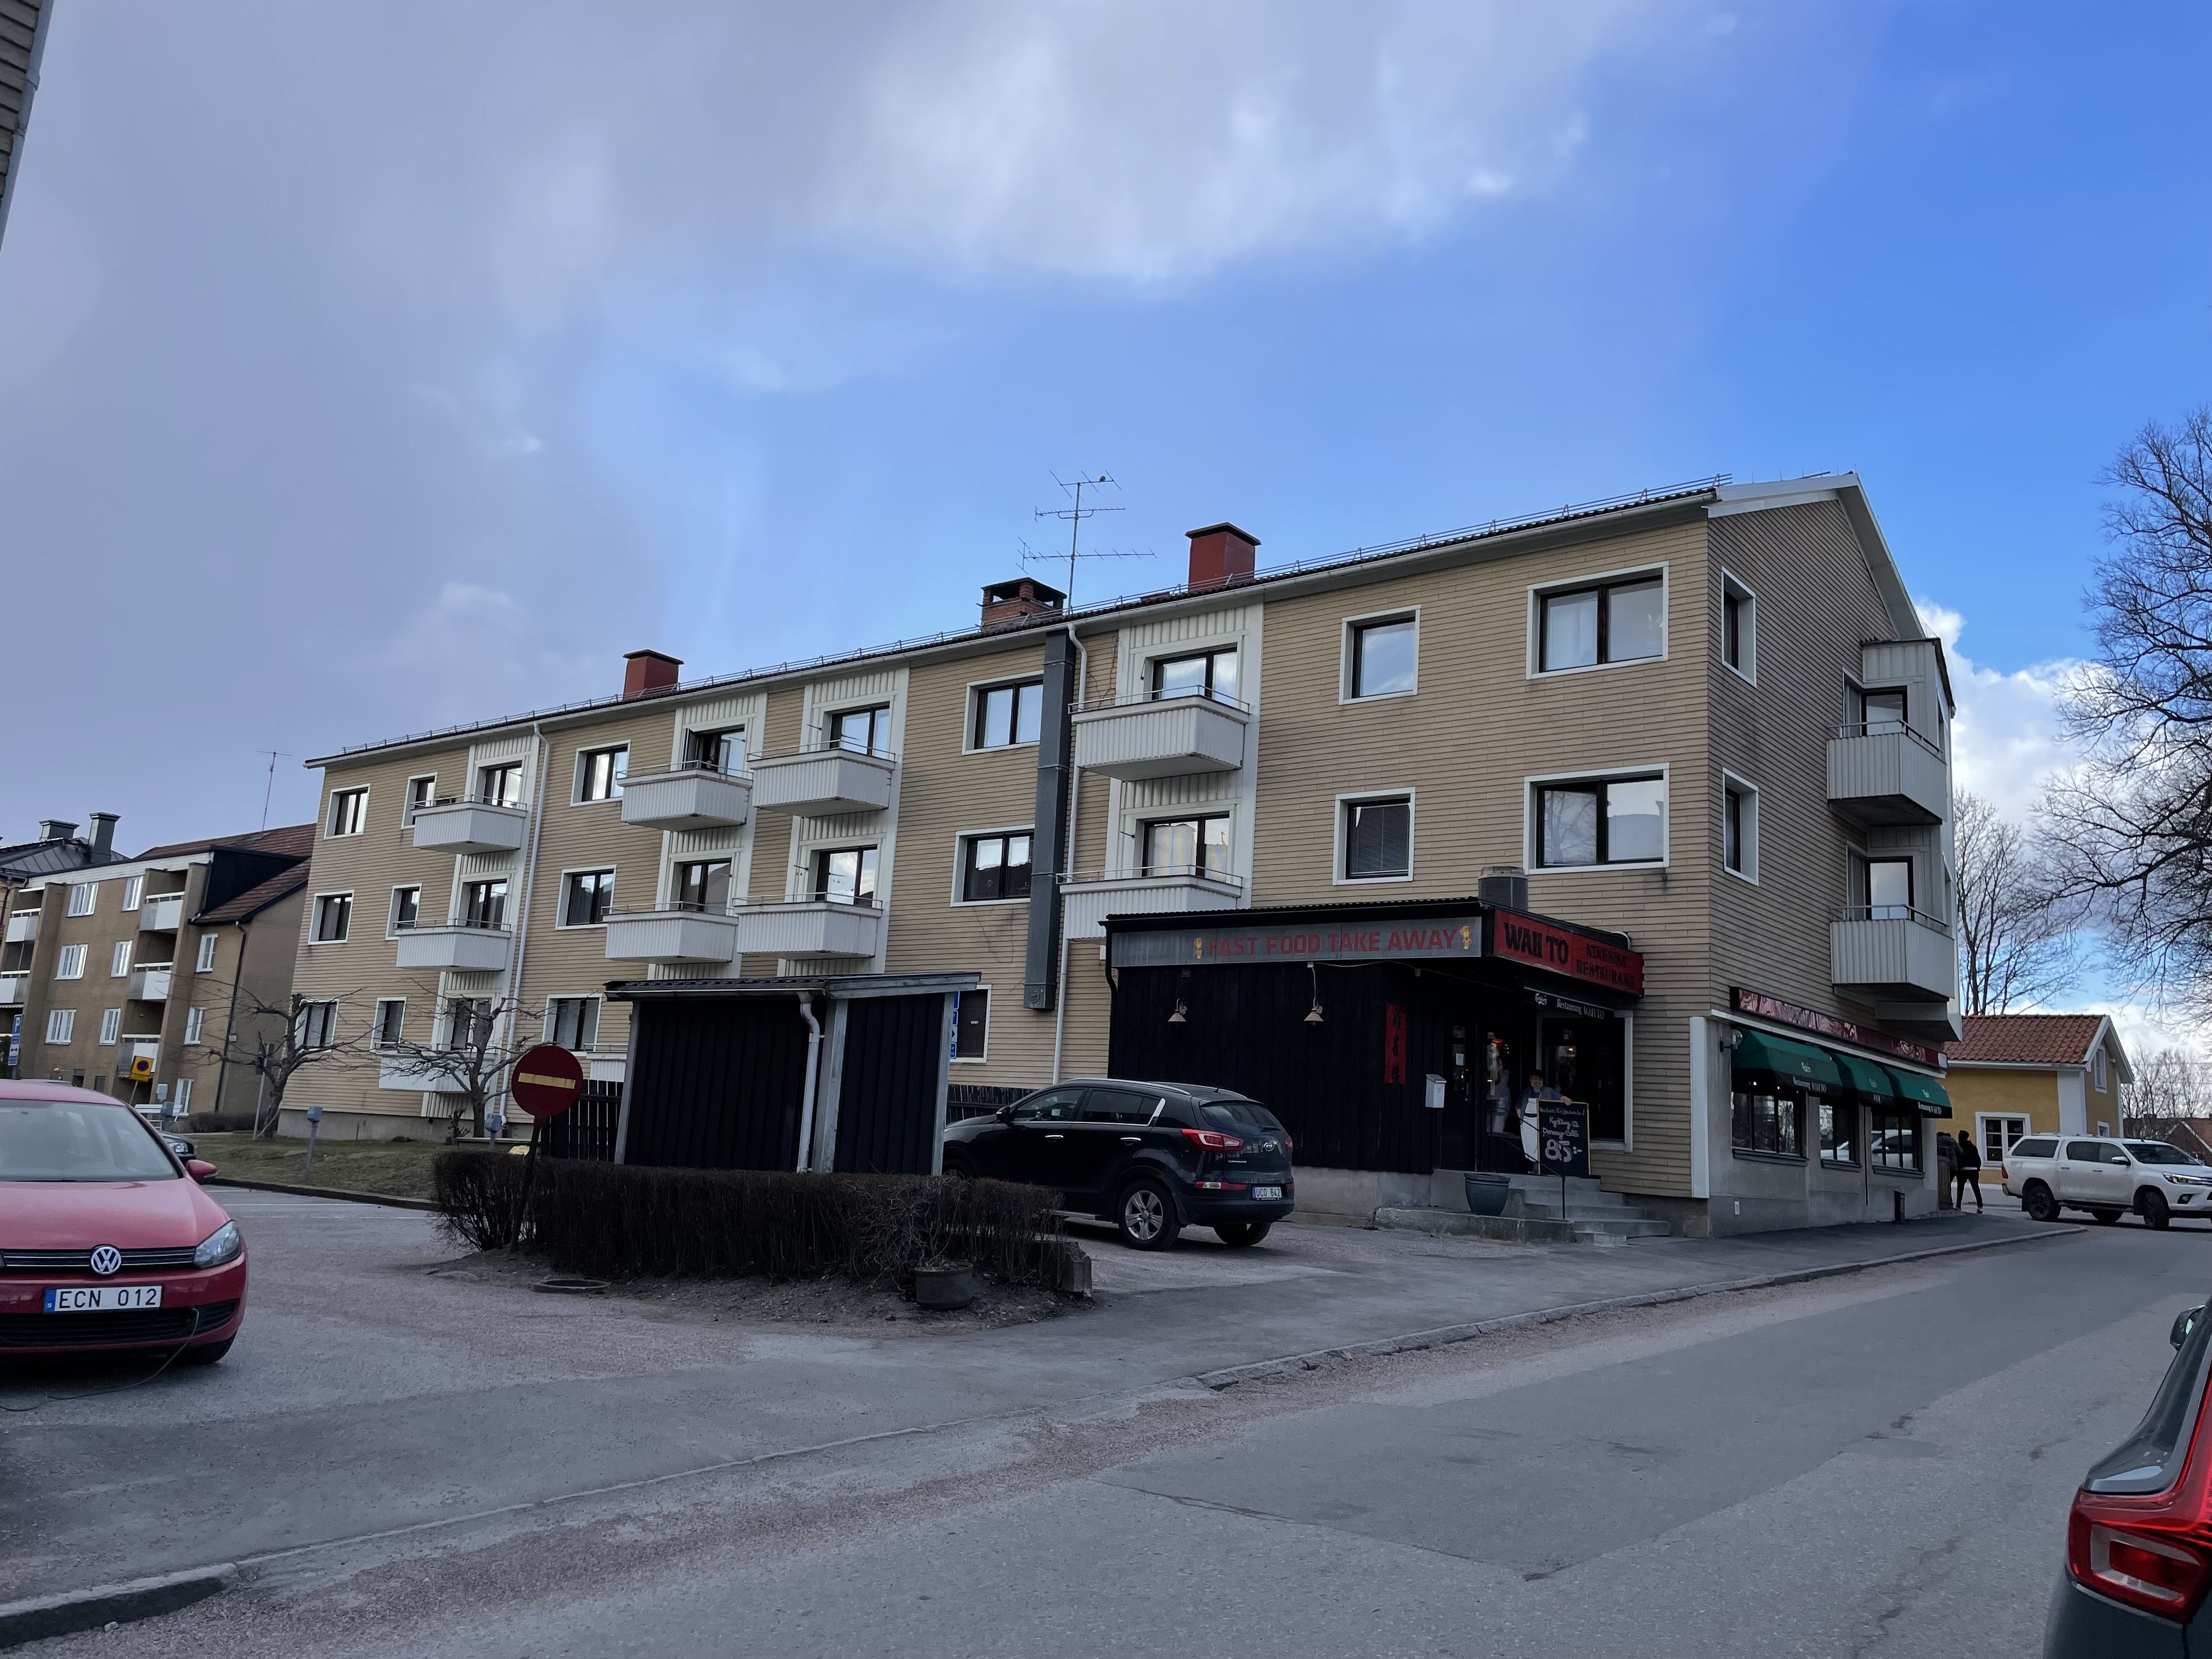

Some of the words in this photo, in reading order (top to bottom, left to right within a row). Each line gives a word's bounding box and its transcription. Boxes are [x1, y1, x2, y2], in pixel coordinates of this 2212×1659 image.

[1209, 937, 1260, 957] FAST
[1266, 934, 1321, 955] FOOD
[1328, 932, 1381, 953] TAKE
[1387, 929, 1458, 951] AWAY
[1504, 922, 1543, 958] WAH
[1546, 935, 1569, 966] TO
[1586, 943, 1628, 968] KINESISK
[1576, 958, 1635, 989] RESTAURANG
[1556, 998, 1582, 1015] Restaurang
[1583, 1006, 1596, 1018] WAH
[1596, 1009, 1605, 1020] TO
[14, 1017, 20, 1033] P
[1270, 1186, 1281, 1197] 642
[59, 1290, 101, 1308] ECN
[117, 1288, 157, 1307] 012
